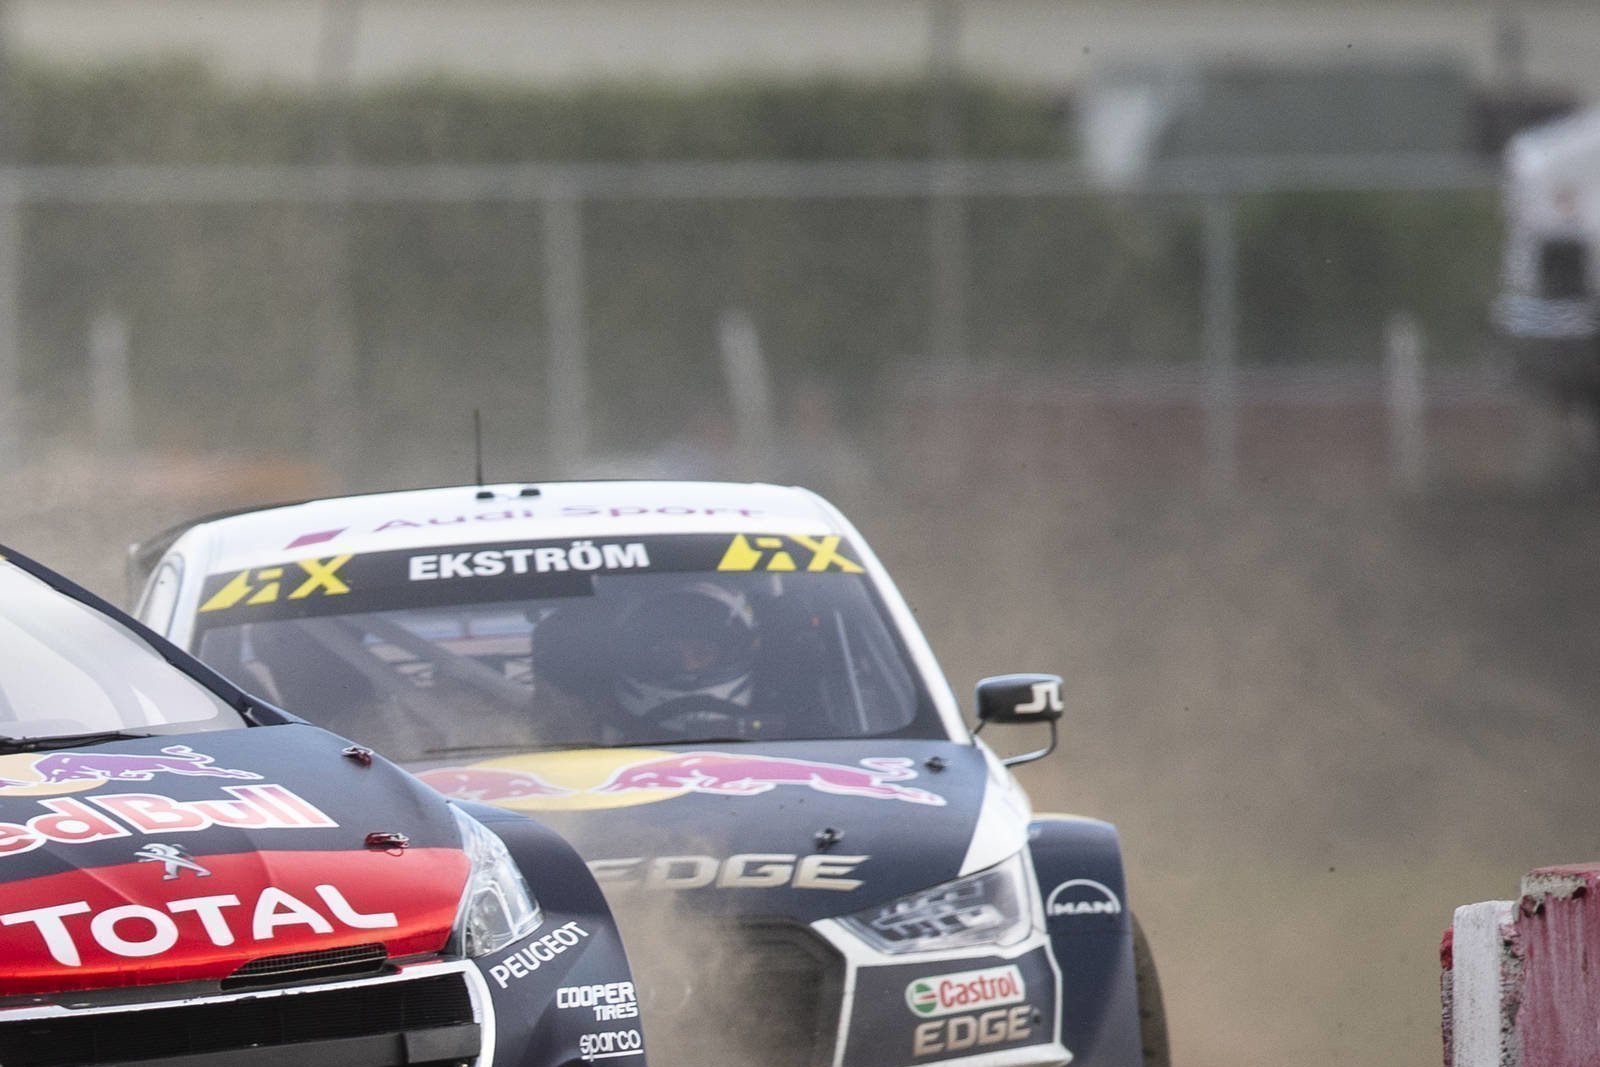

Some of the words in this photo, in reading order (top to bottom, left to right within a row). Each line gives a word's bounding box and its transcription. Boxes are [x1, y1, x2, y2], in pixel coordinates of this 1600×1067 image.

[409, 541, 650, 581] EKSTRÖM
[85, 784, 341, 835] Bull
[586, 853, 872, 892] EDGE
[489, 921, 590, 989] PEUGEOT
[556, 981, 637, 1009] COOPER
[939, 971, 1020, 1009] Castrol
[593, 1002, 639, 1021] TIRES
[913, 1003, 1033, 1058] EDGE
[579, 1029, 644, 1063] sparco
